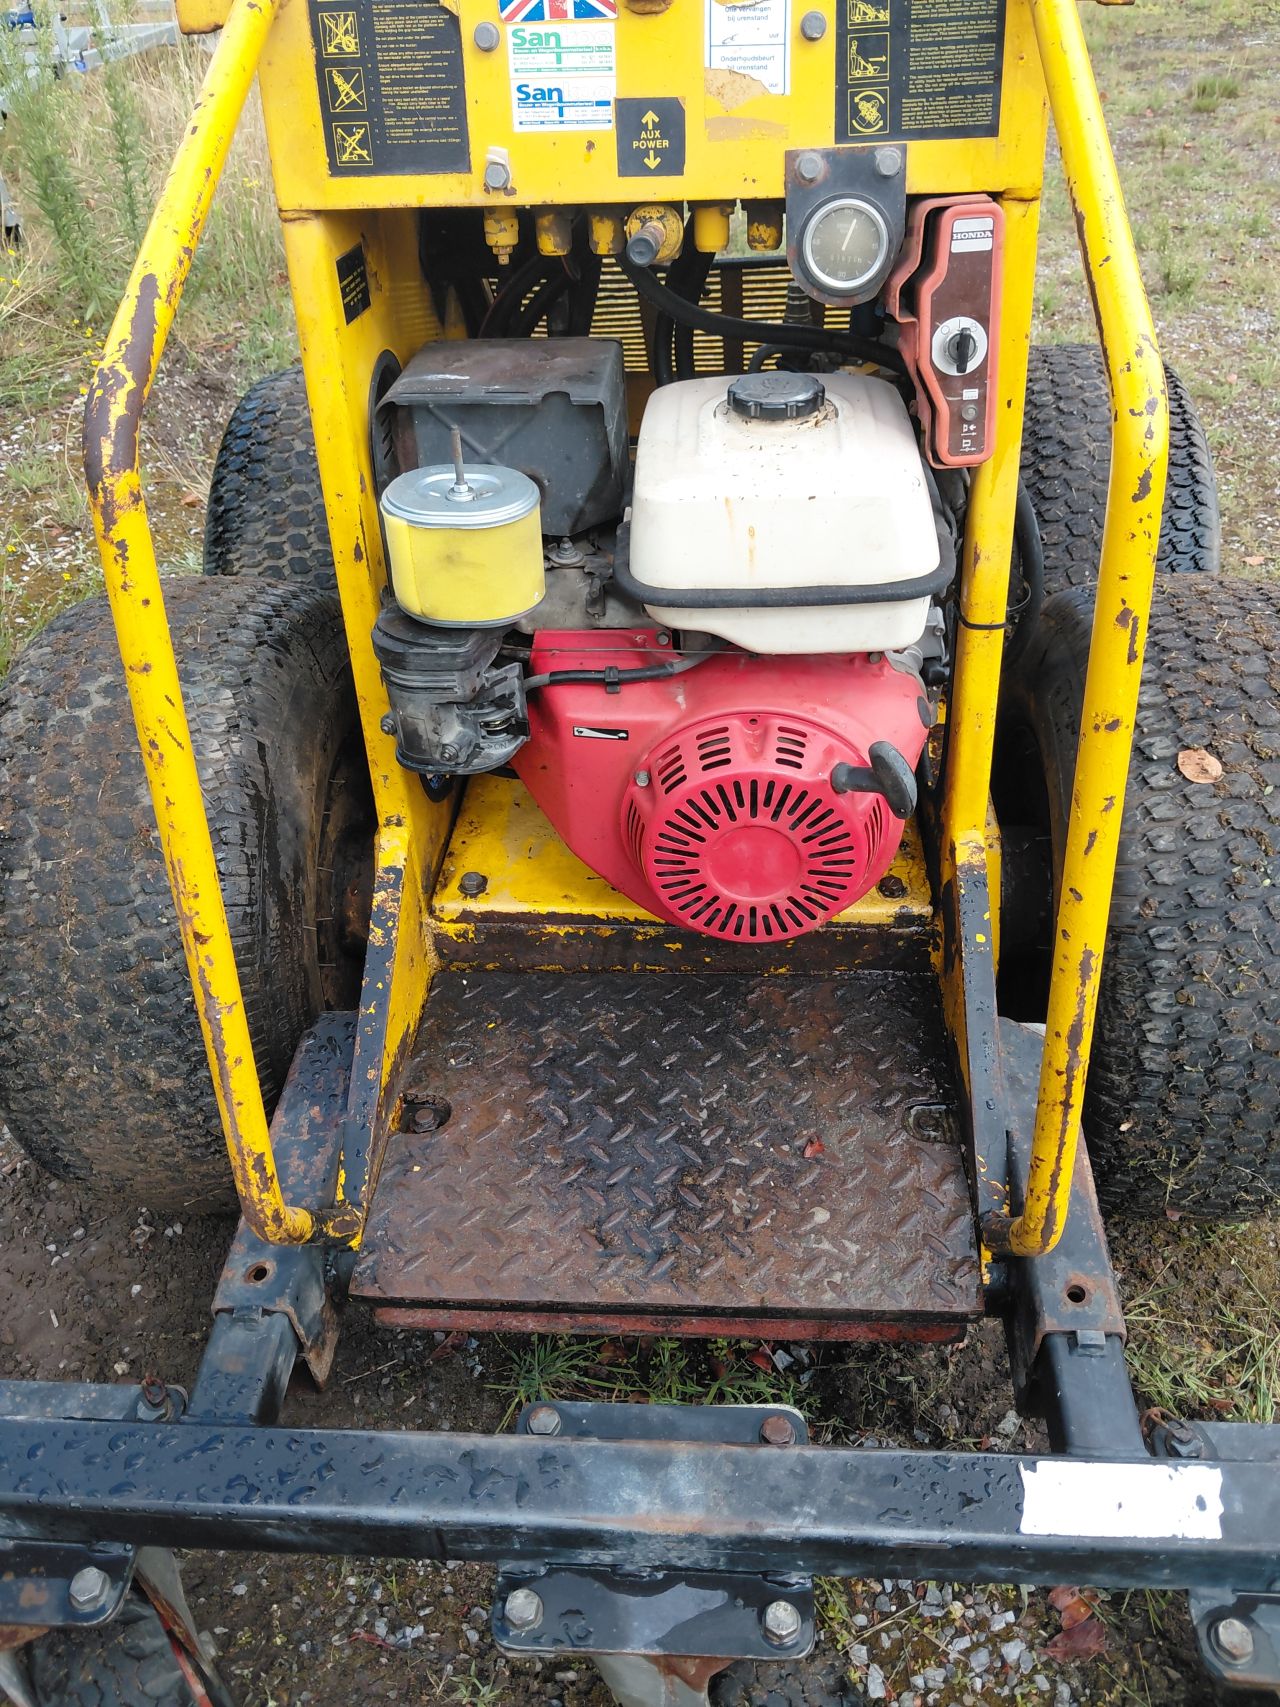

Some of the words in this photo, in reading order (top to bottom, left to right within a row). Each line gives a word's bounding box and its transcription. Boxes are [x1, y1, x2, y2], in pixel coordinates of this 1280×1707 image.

[640, 130, 661, 139] AUX
[632, 140, 669, 149] POWER
[952, 231, 993, 240] HONDA
